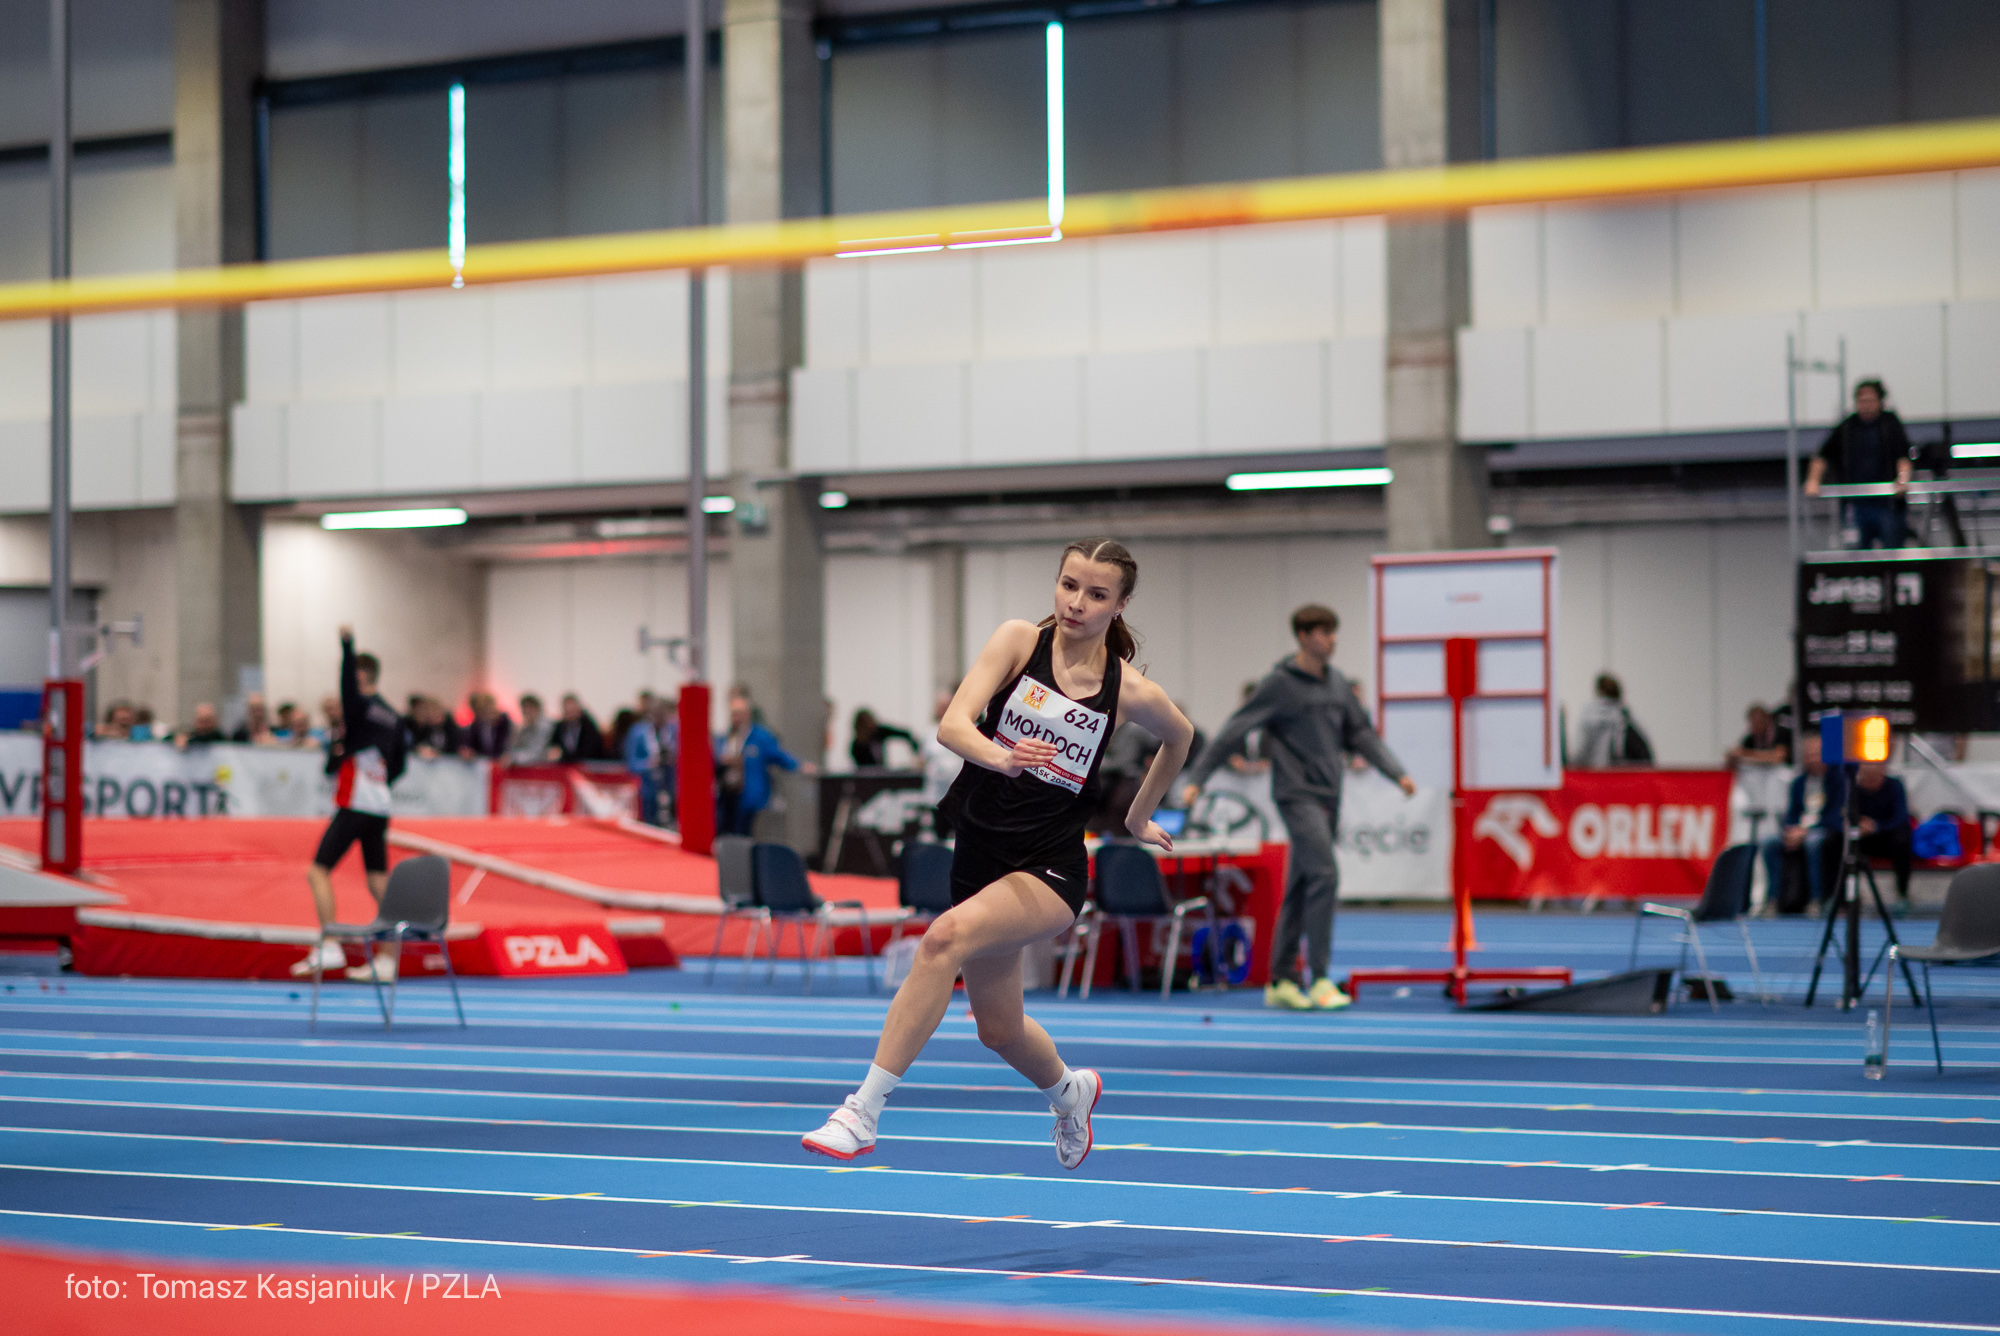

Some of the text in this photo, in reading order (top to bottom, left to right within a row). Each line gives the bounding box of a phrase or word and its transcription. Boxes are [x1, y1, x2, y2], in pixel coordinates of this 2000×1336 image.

[1004, 709, 1092, 766] MOŁDOCH
[1064, 709, 1100, 734] 624
[1050, 776, 1072, 787] 2024
[1569, 803, 1715, 859] ORLEN
[505, 934, 610, 968] PZLA
